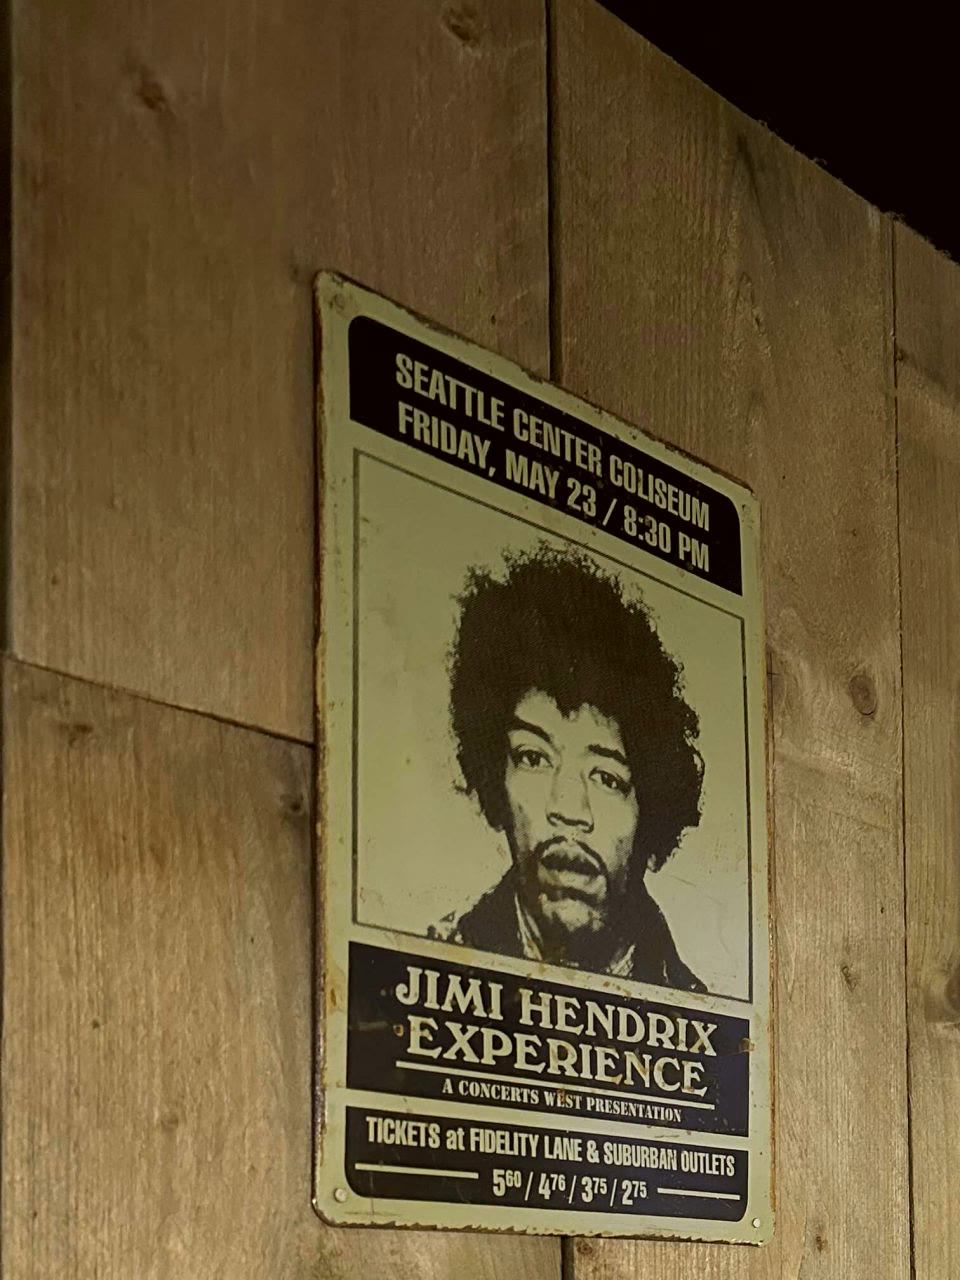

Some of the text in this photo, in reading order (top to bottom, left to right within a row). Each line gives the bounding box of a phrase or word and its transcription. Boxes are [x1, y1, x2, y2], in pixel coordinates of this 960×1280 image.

[396, 352, 710, 532] SEATTLE CENTER COLISEUM
[398, 401, 497, 477] FRIDAY,
[505, 449, 560, 500] MAY
[566, 478, 597, 518] 23
[623, 504, 672, 555] 8:30
[678, 533, 710, 573] PM
[396, 966, 718, 1057] JIMI HENDRIX
[407, 1015, 709, 1098] EXPERIENCE
[442, 1079, 682, 1123] A CONCERTS WEST PRESENTATION
[366, 1116, 736, 1178] TICKETS at FIDELITY LANE & SUBURBAN OUTLETS
